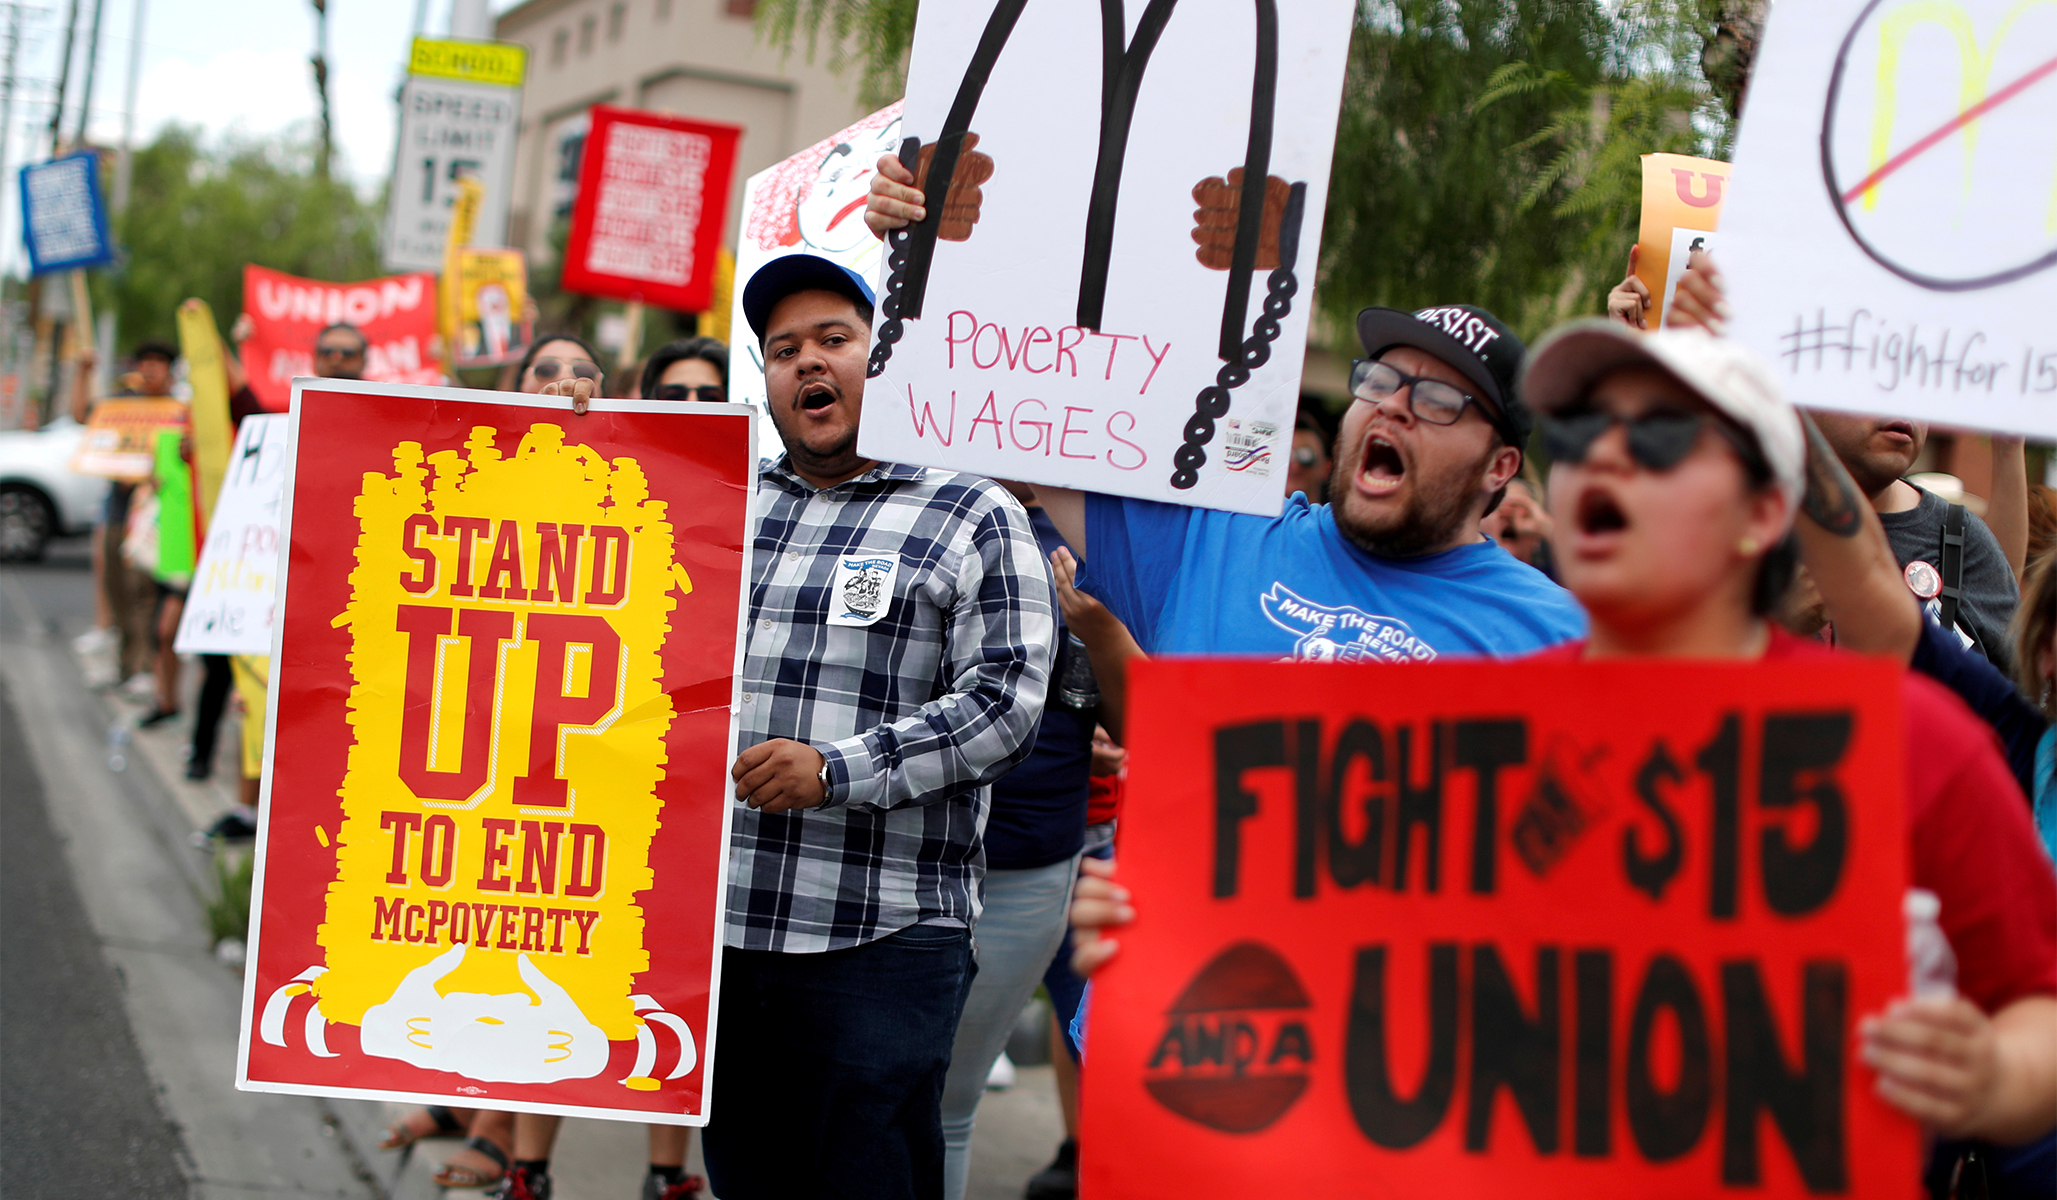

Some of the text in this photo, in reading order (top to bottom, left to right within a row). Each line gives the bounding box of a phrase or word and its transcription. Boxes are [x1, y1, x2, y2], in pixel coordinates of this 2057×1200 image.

[414, 93, 512, 124] SPEED
[414, 123, 496, 150] LIMIT
[1671, 168, 1731, 209] U
[255, 277, 423, 326] UNION
[908, 383, 1147, 471] WAGES
[400, 513, 632, 608] STAND
[877, 560, 892, 568] ROAD
[1278, 599, 1429, 661] MAKE THE ROAD
[396, 604, 626, 812] UP
[1212, 713, 1530, 900] FIGHT
[1622, 708, 1855, 920] $15
[380, 811, 608, 900] TO END
[371, 896, 602, 957] McPOVERTY
[1267, 1022, 1314, 1064] A
[1344, 940, 1848, 1194] UNION
